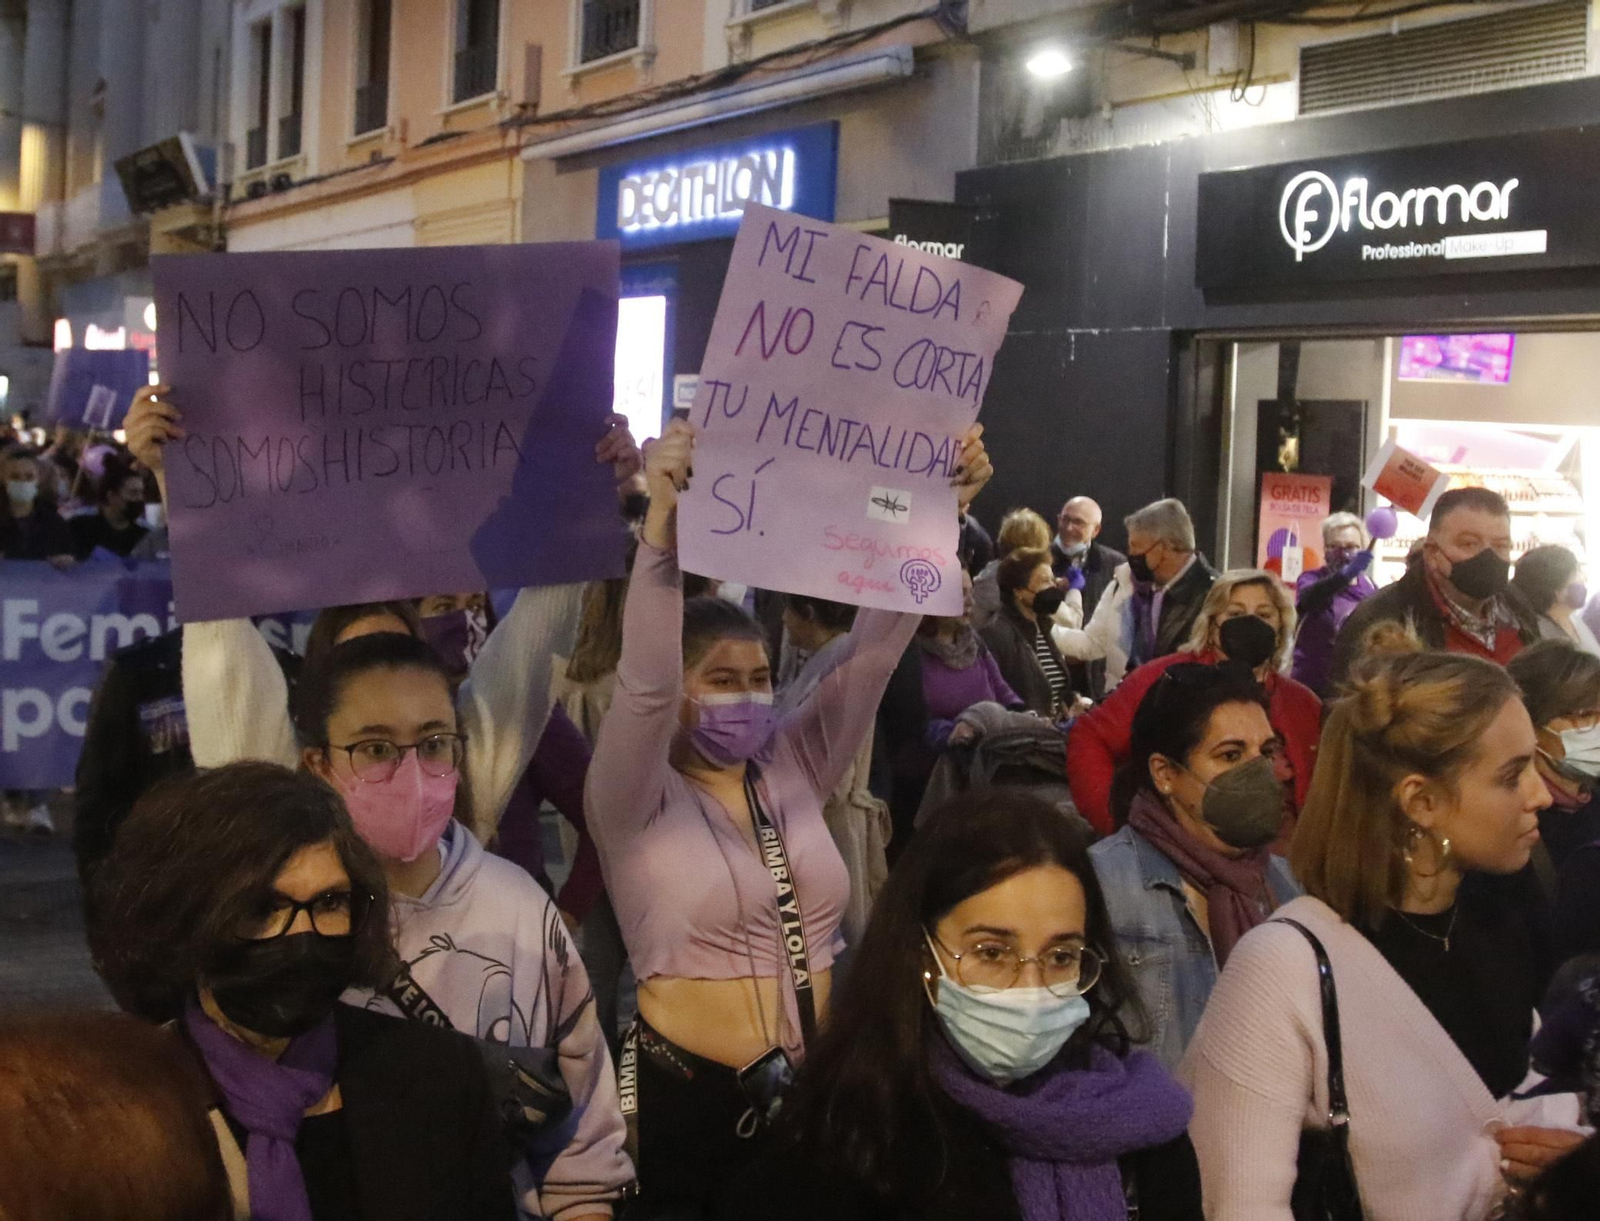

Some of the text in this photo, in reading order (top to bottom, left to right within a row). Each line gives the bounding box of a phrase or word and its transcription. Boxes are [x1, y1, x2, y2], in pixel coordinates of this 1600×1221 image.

[617, 148, 795, 231] DECATHLON
[1341, 177, 1520, 232] flormar
[757, 220, 961, 321] MI FALDA
[1361, 239, 1447, 261] Professional
[178, 288, 265, 353] NO
[292, 282, 483, 350] SOMOS
[734, 300, 815, 361] NO
[831, 320, 886, 371] ES
[702, 380, 748, 428] TU
[1270, 484, 1321, 504] GRATIS
[761, 827, 810, 987] BIMBA Y LOLA
